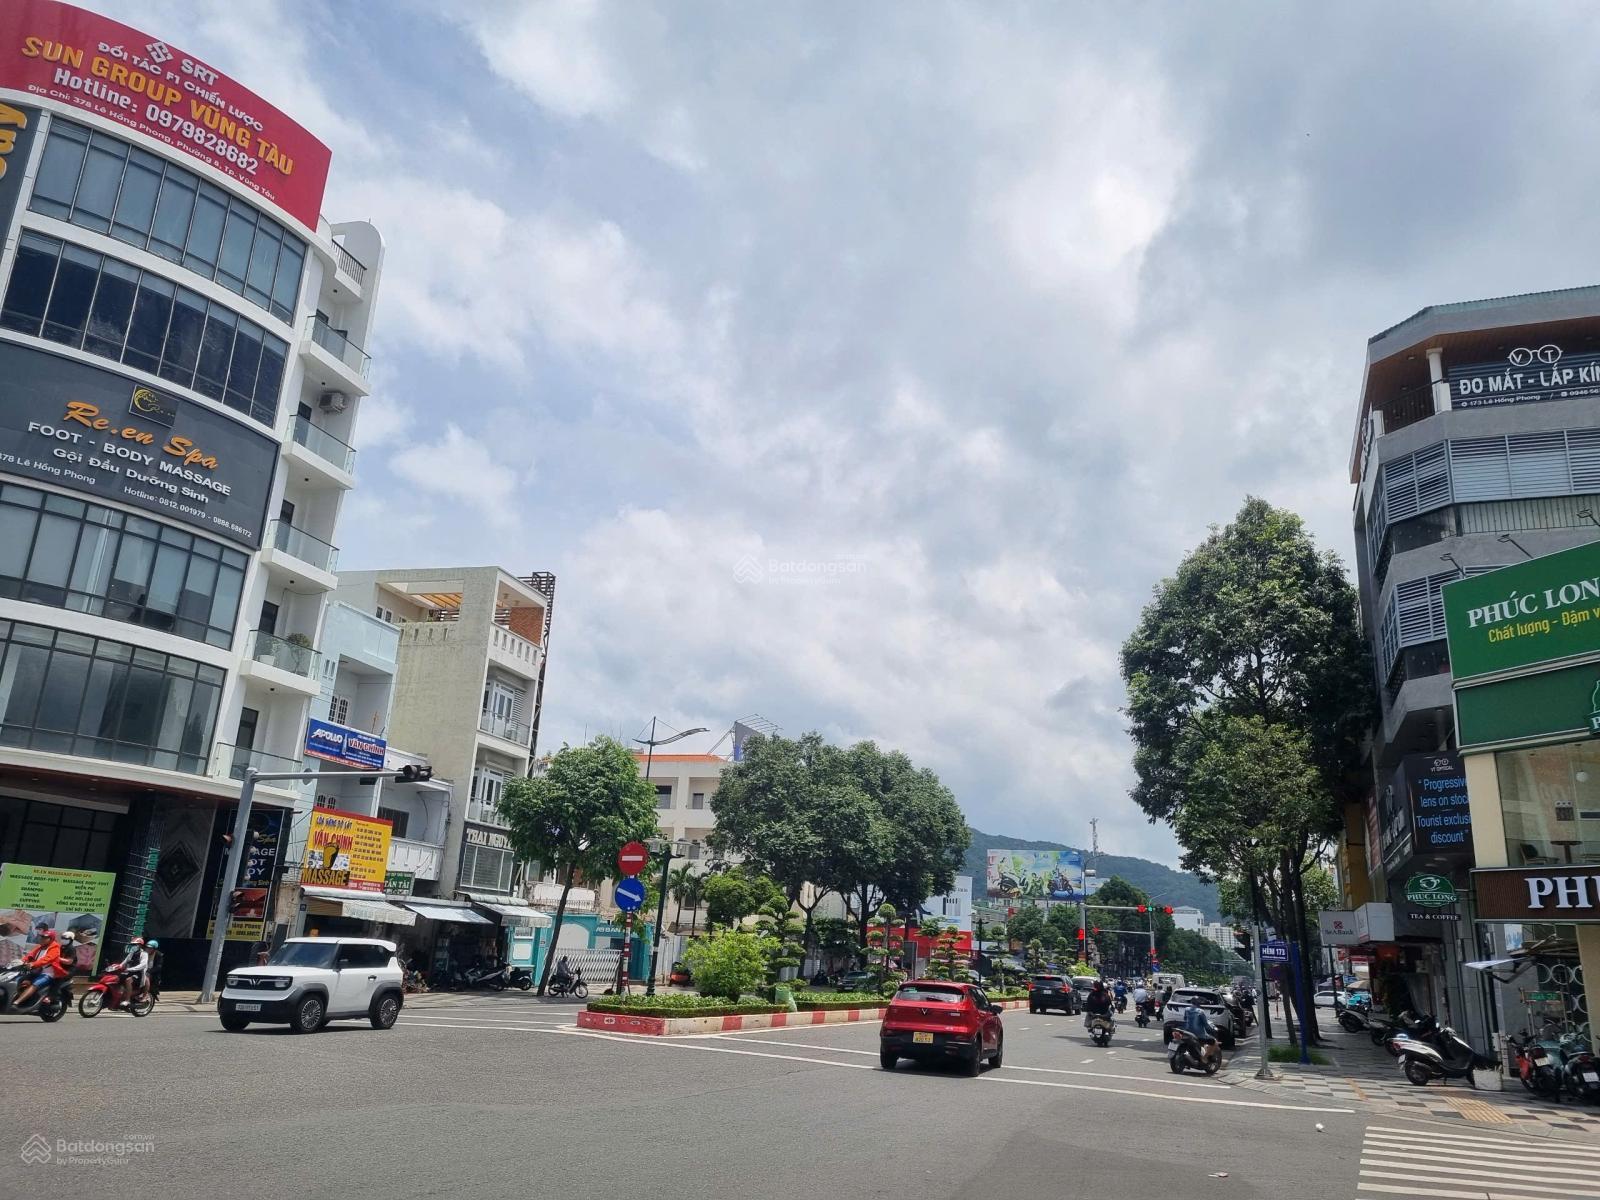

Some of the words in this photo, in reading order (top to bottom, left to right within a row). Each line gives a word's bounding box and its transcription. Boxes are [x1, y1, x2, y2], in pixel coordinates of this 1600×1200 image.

[181, 58, 219, 86] SRT
[97, 41, 129, 61] ĐỐI
[132, 55, 162, 75] TÁC
[166, 72, 180, 85] F1
[184, 81, 226, 108] CHIẾN
[228, 105, 264, 132] LƯỢC
[21, 36, 84, 69] SUN
[91, 56, 182, 107] GROUP
[190, 99, 251, 149] VŨNG
[257, 138, 294, 175] TÀU
[73, 96, 92, 108] 378
[53, 68, 138, 113] Hotline:
[145, 103, 259, 175] 0979828682
[1459, 377, 1484, 395] ĐO
[1487, 367, 1524, 392] MẮT
[1540, 362, 1574, 387] LẮP
[63, 401, 154, 445] Re.en
[163, 436, 219, 470] Spa
[28, 421, 82, 444] FOOT
[103, 442, 154, 466] BODY
[159, 461, 232, 496] MASSAGE
[53, 448, 83, 464] Gội
[126, 468, 178, 494] Dưỡng
[64, 469, 96, 485] Phong
[124, 486, 158, 502] Hotline:
[1467, 590, 1539, 629] PHÚC
[1488, 622, 1515, 643] Chất
[1517, 618, 1550, 637] lượng
[1561, 609, 1590, 627] Đậm
[311, 728, 344, 744] APOLLO
[1420, 795, 1437, 808] lens
[1438, 796, 1449, 806] on
[1416, 814, 1442, 828] Tourist
[303, 867, 347, 886] MASSAGE
[1433, 893, 1457, 902] LONG
[1276, 948, 1286, 956] 173
